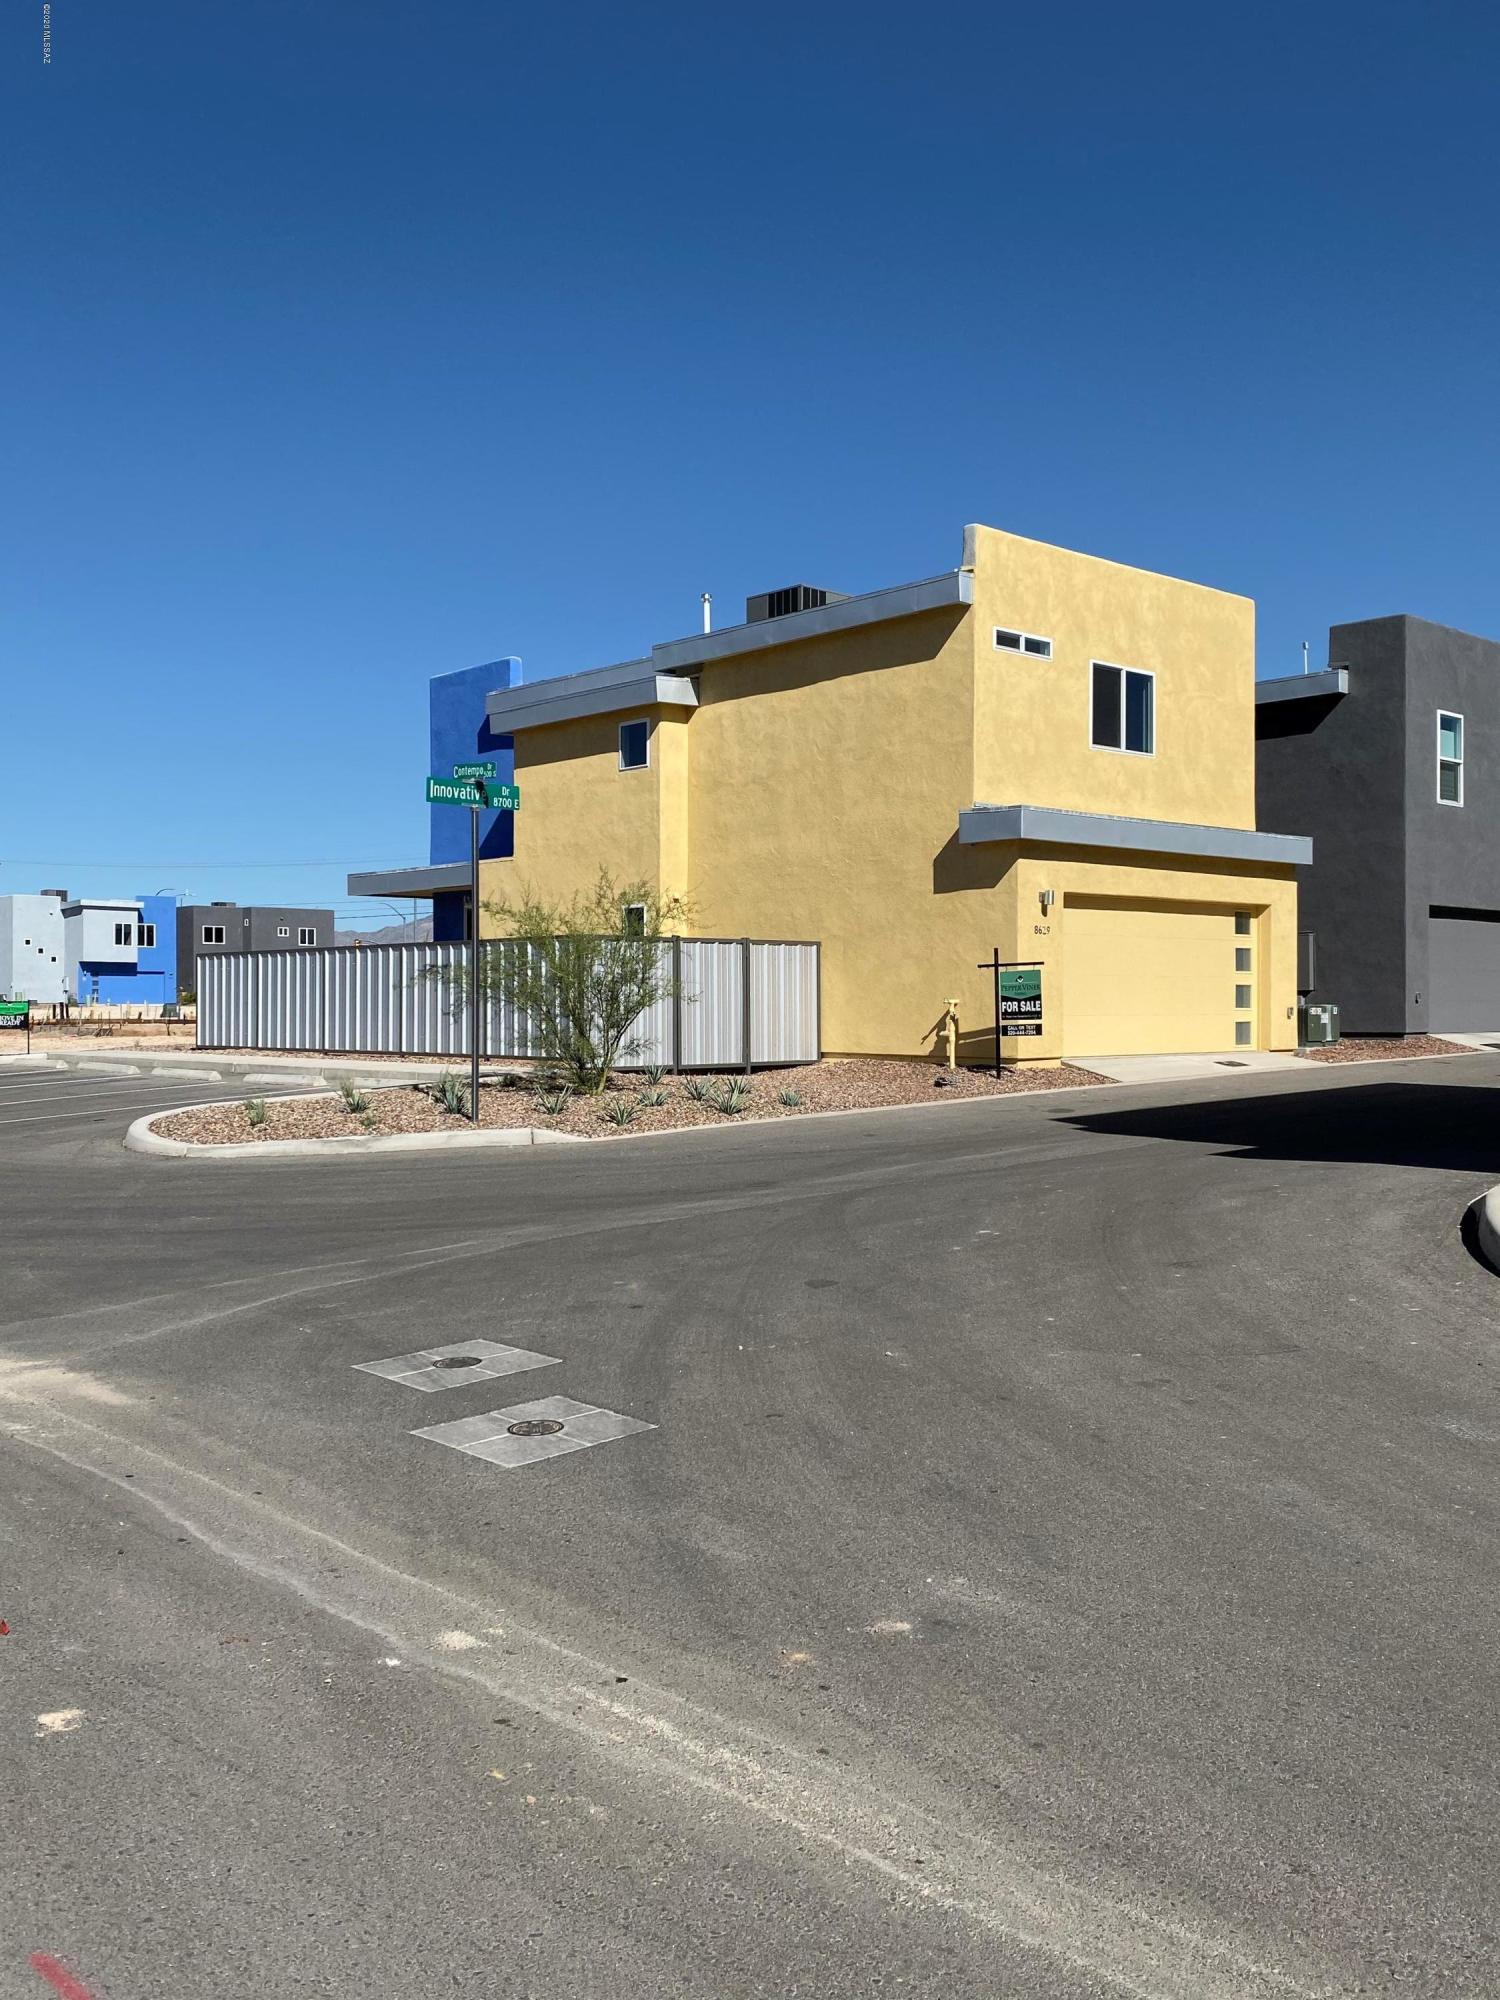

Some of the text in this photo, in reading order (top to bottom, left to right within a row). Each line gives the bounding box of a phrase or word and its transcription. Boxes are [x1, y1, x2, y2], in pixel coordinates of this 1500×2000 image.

[453, 765, 484, 778] Contempo
[501, 786, 510, 796] Dr
[493, 797, 519, 809] 8700 E
[1001, 1000, 1041, 1012] FOR SALE
